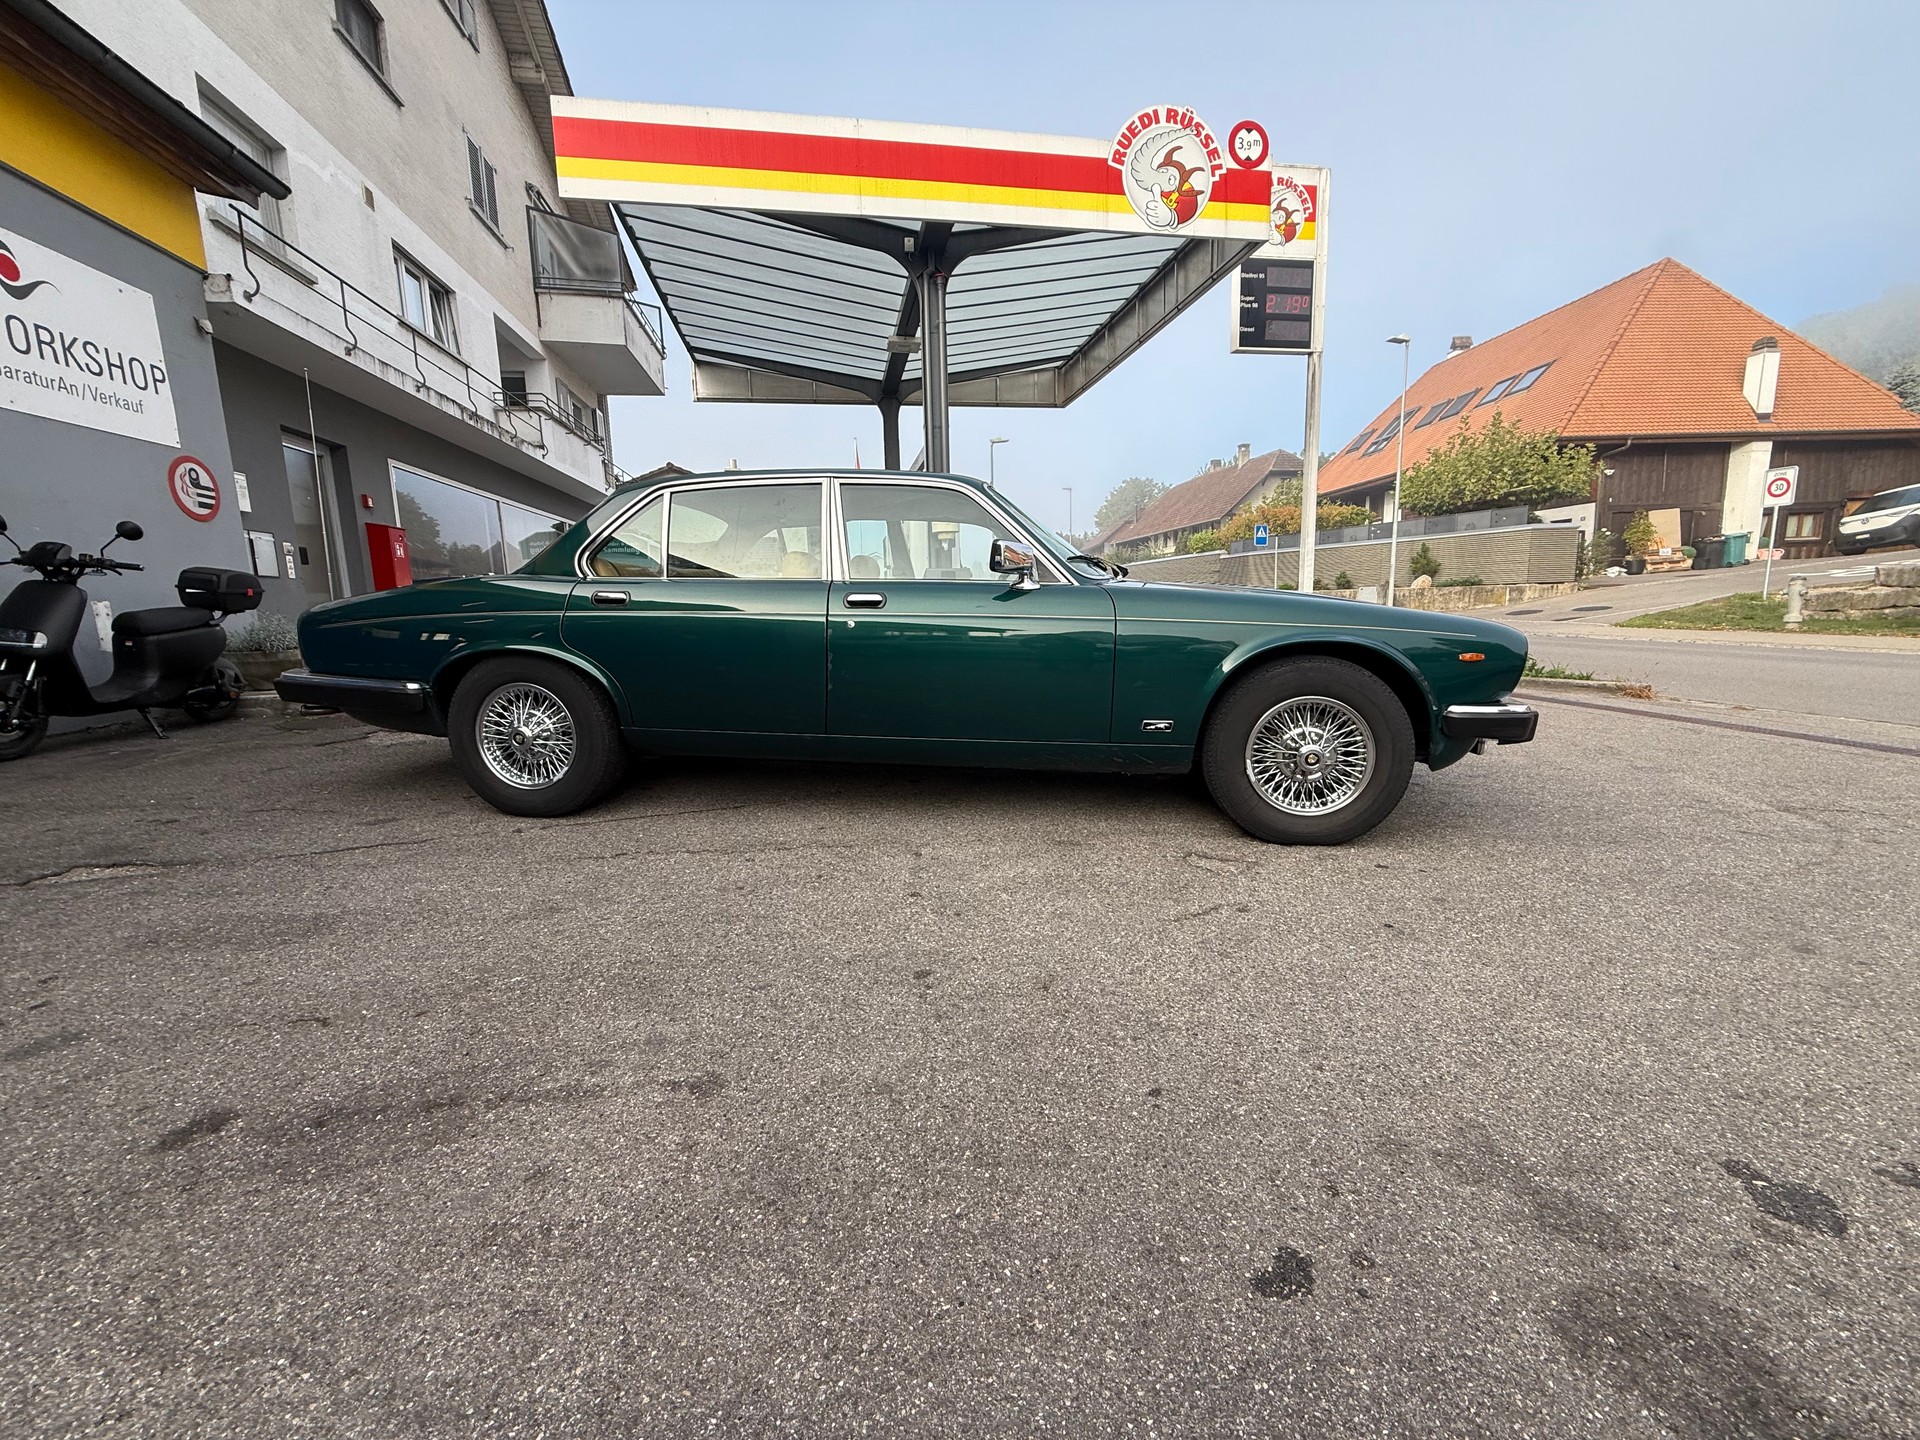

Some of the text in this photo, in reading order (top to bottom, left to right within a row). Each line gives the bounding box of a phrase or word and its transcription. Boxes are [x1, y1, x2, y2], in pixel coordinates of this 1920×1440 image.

[1111, 108, 1223, 177] RUEDI RÜSSEL
[1277, 176, 1310, 215] RÜSSEL
[0, 365, 144, 415] araturAn/Verkauf
[1774, 483, 1784, 491] 30
[603, 547, 640, 555] Sammlung
